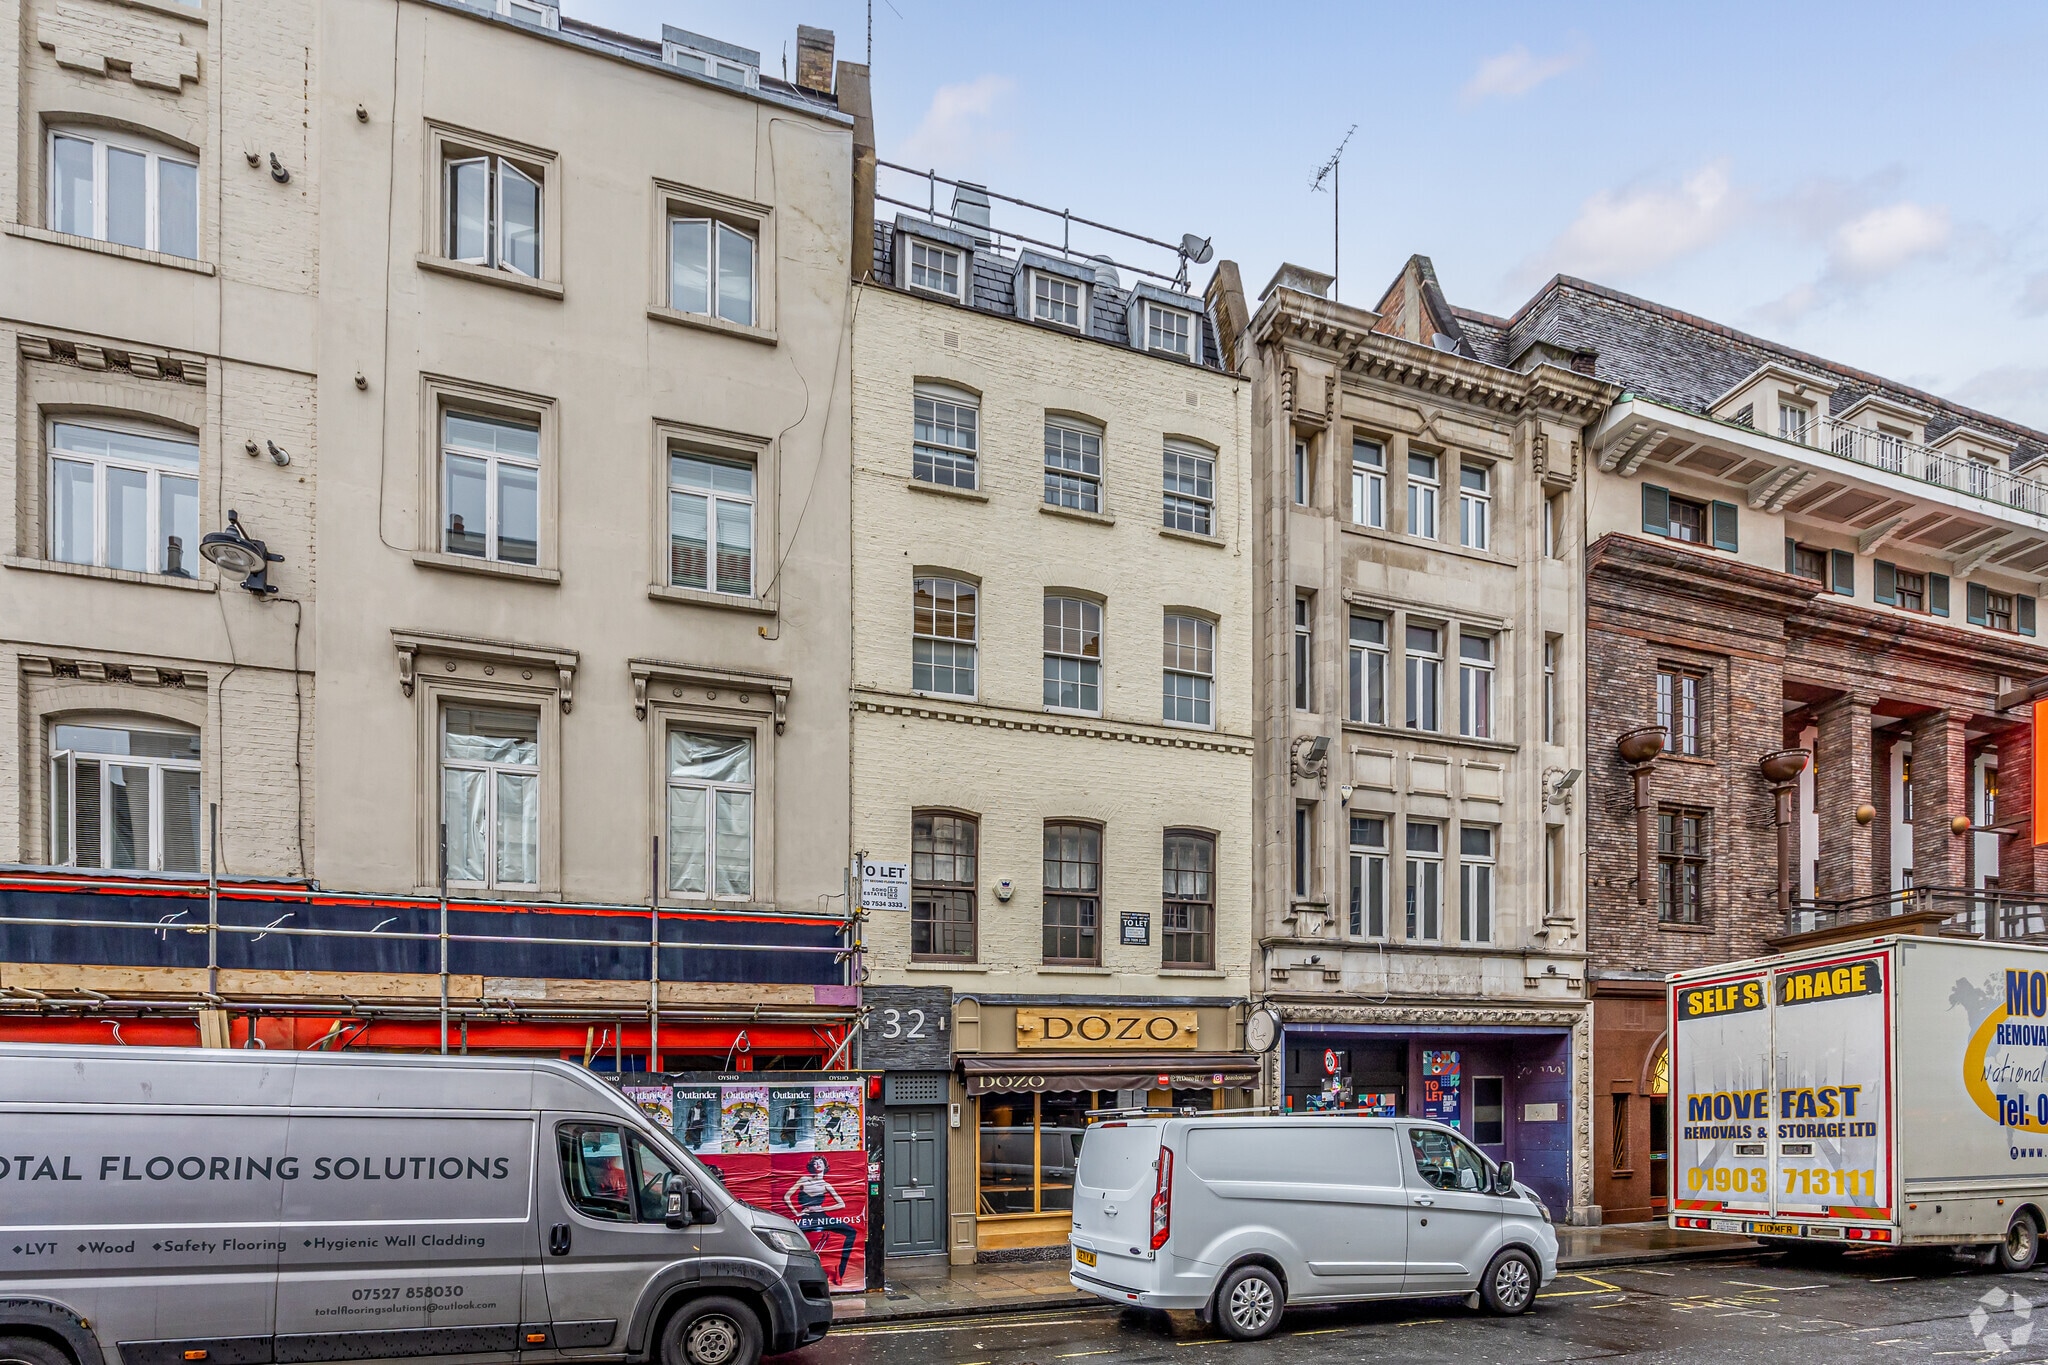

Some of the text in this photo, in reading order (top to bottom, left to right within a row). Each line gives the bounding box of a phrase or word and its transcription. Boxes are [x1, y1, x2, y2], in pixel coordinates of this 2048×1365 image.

[863, 865, 905, 878] O LET
[1688, 965, 1867, 1015] SELF SORAGE
[2005, 968, 2048, 1019] MO
[882, 1008, 926, 1039] 32
[1039, 1016, 1179, 1041] DOZO
[1996, 1023, 2048, 1047] REMOVA
[1326, 1056, 1334, 1067] 20
[1980, 1053, 2047, 1083] National
[979, 1075, 1045, 1088] DOZO
[1424, 1080, 1439, 1091] TO
[1425, 1091, 1444, 1102] LET
[1687, 1084, 1862, 1122] MOVE FAST
[1996, 1094, 2030, 1126] Tel:
[1684, 1121, 1877, 1140] REMOVALS & STORAGE LTD
[100, 1156, 299, 1181] FLOORING
[312, 1156, 510, 1181] SOLUTIONS
[1687, 1167, 1875, 1197] 01903 713111
[791, 1215, 861, 1226] VEY NICHOLS
[1774, 1224, 1793, 1235] MFR
[25, 1234, 486, 1255] LVT Wood Safety Flooring Hygienic Wall Cladding
[352, 1285, 464, 1301] 07527 858030
[315, 1301, 497, 1316] totalflooringsolutions@outlook.com
